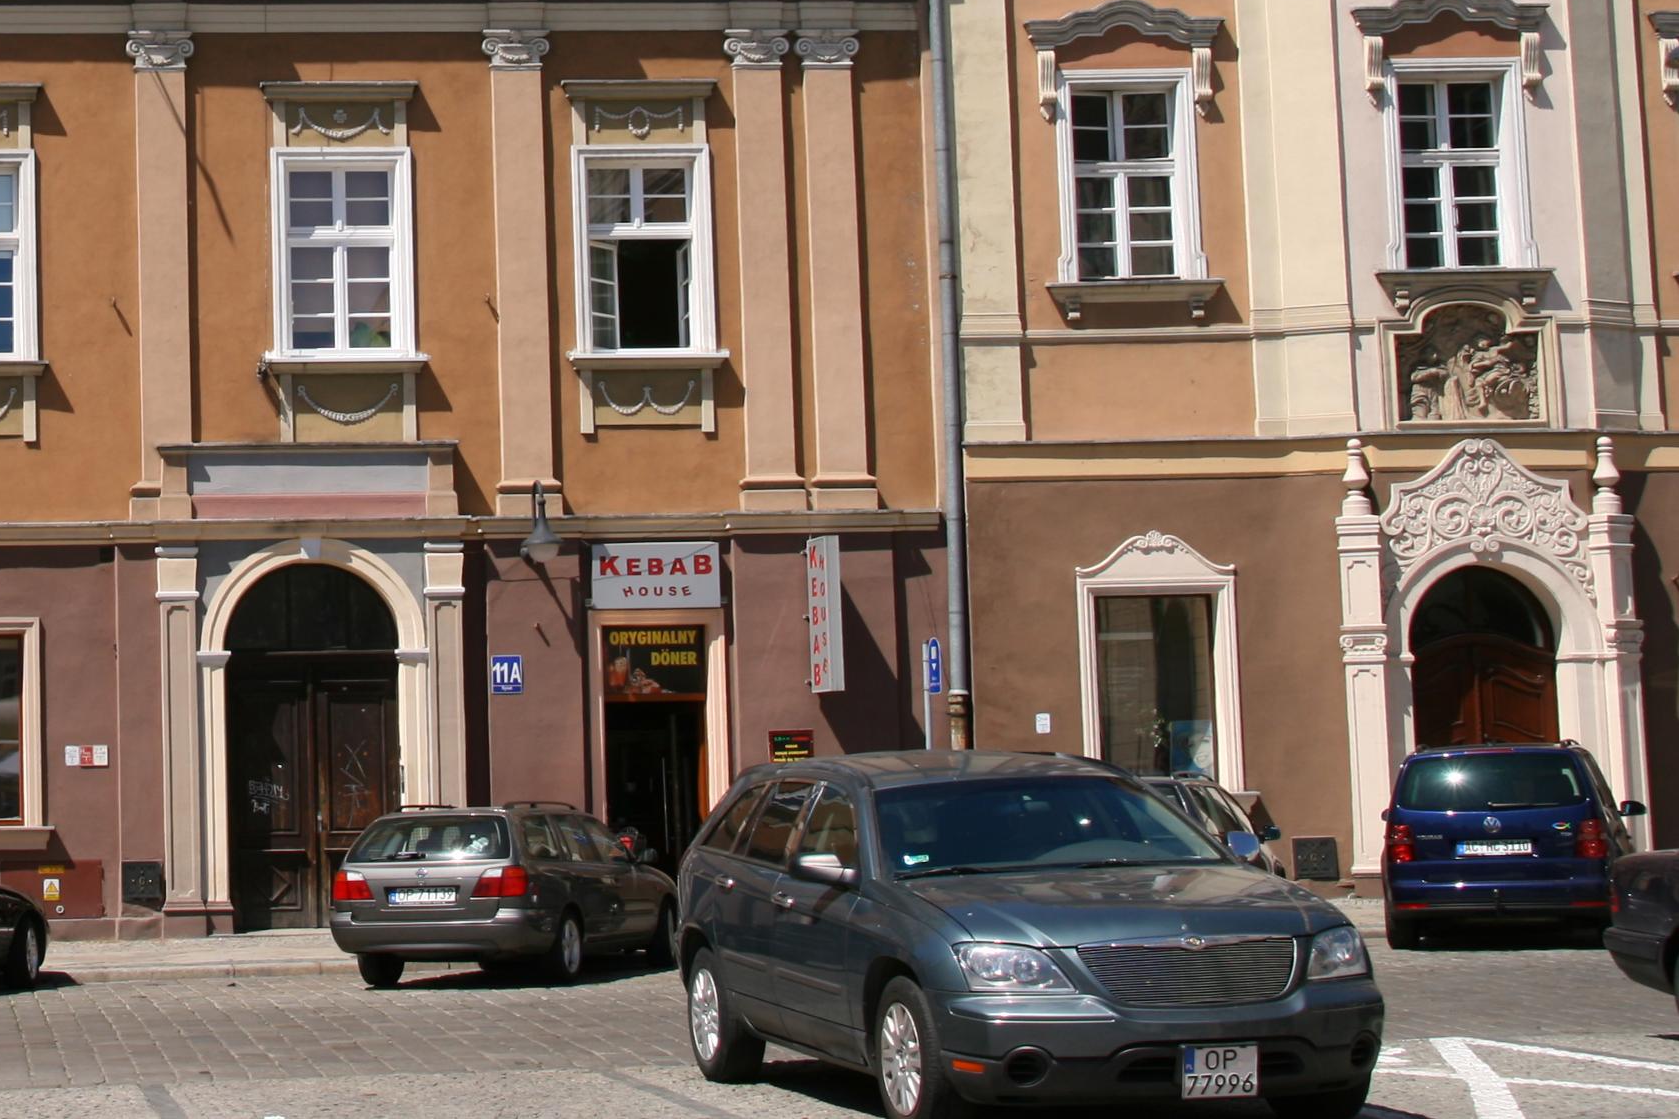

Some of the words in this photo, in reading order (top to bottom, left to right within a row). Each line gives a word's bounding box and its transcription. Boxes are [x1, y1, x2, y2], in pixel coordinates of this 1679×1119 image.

[599, 554, 713, 576] KEBAB
[622, 586, 692, 598] HOUSE
[809, 545, 822, 687] KEBAB
[818, 553, 829, 674] HOUSE
[609, 630, 697, 645] ORYGINALNY
[650, 649, 698, 665] DÖNER
[492, 662, 521, 683] 11A
[398, 889, 413, 901] OP
[1205, 1049, 1238, 1071] OP
[1186, 1073, 1254, 1096] 77996
